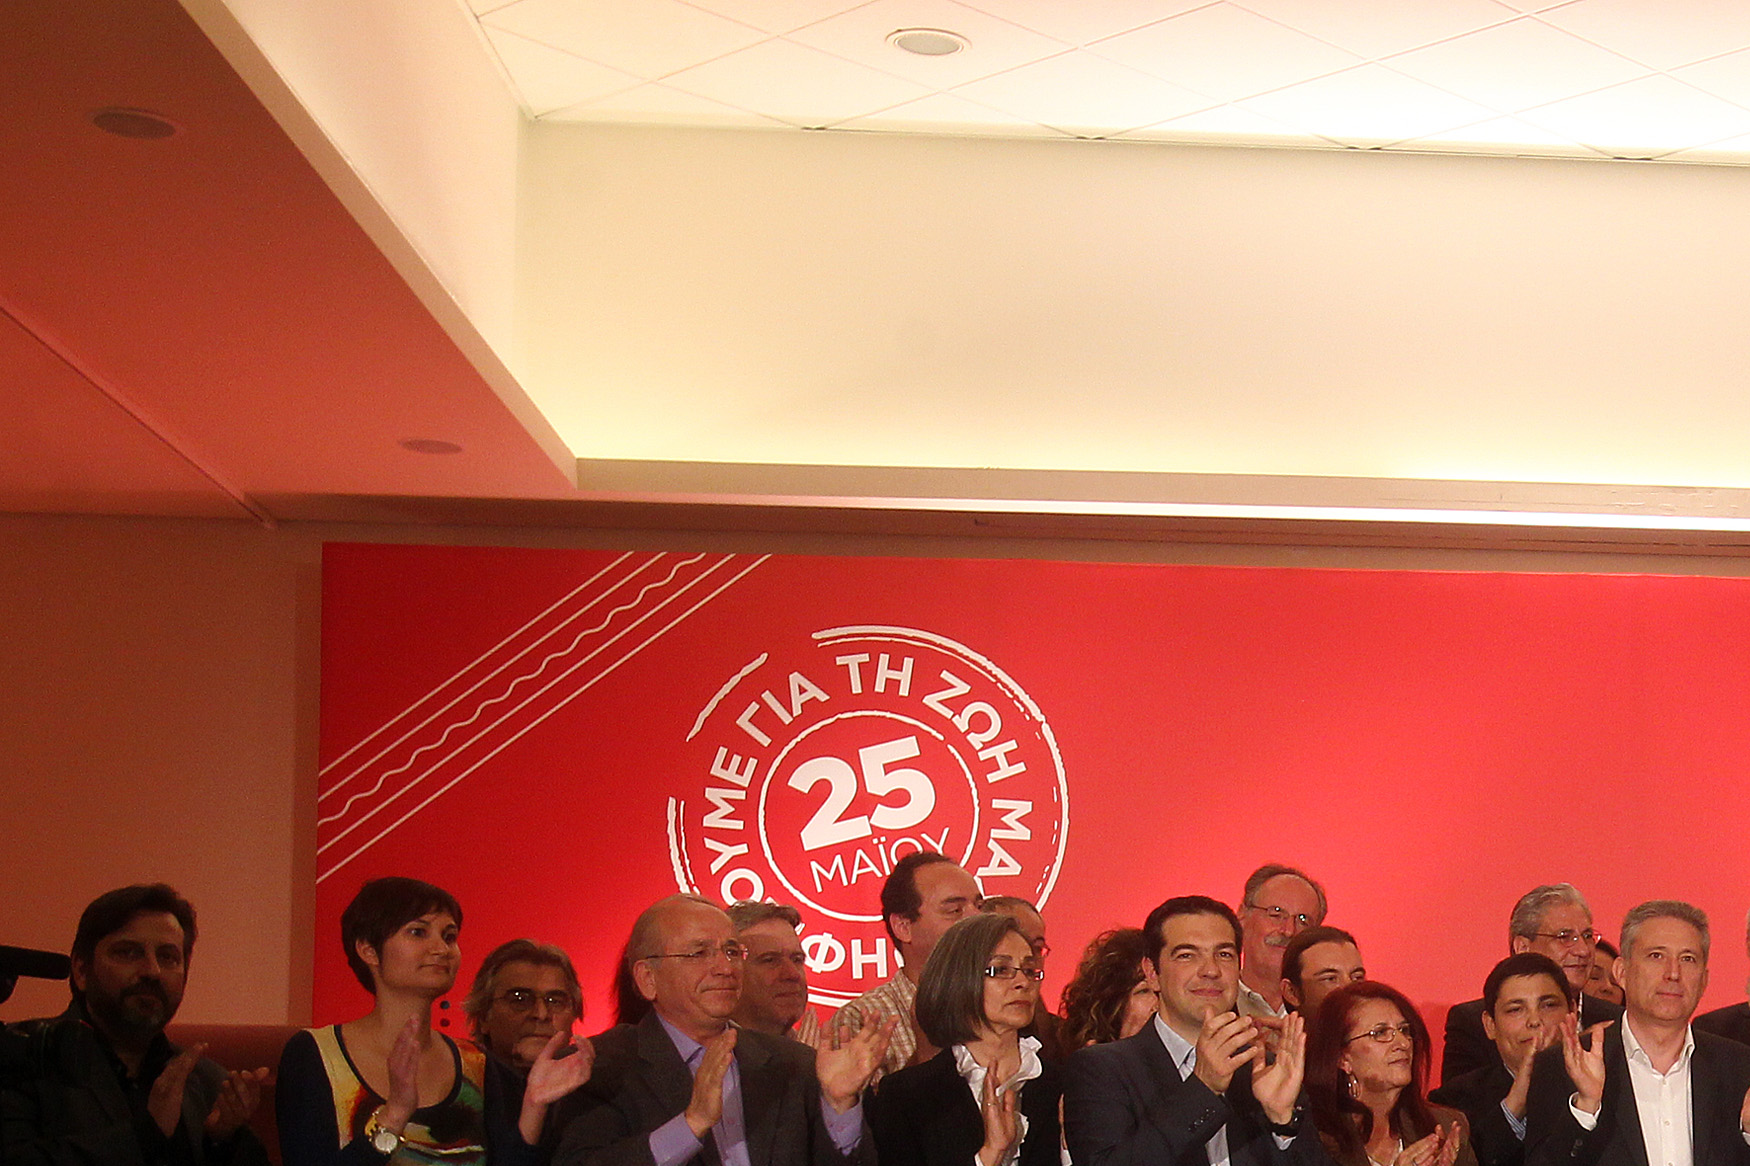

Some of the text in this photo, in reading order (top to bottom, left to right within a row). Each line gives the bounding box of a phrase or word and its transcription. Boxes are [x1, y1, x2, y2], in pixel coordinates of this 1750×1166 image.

[736, 671, 831, 748] ΓΙΑ
[836, 653, 915, 697] ΤΗ
[922, 670, 1027, 784] ΖΩΗ
[788, 736, 936, 852] 25
[973, 799, 1033, 900] ΜΑ
